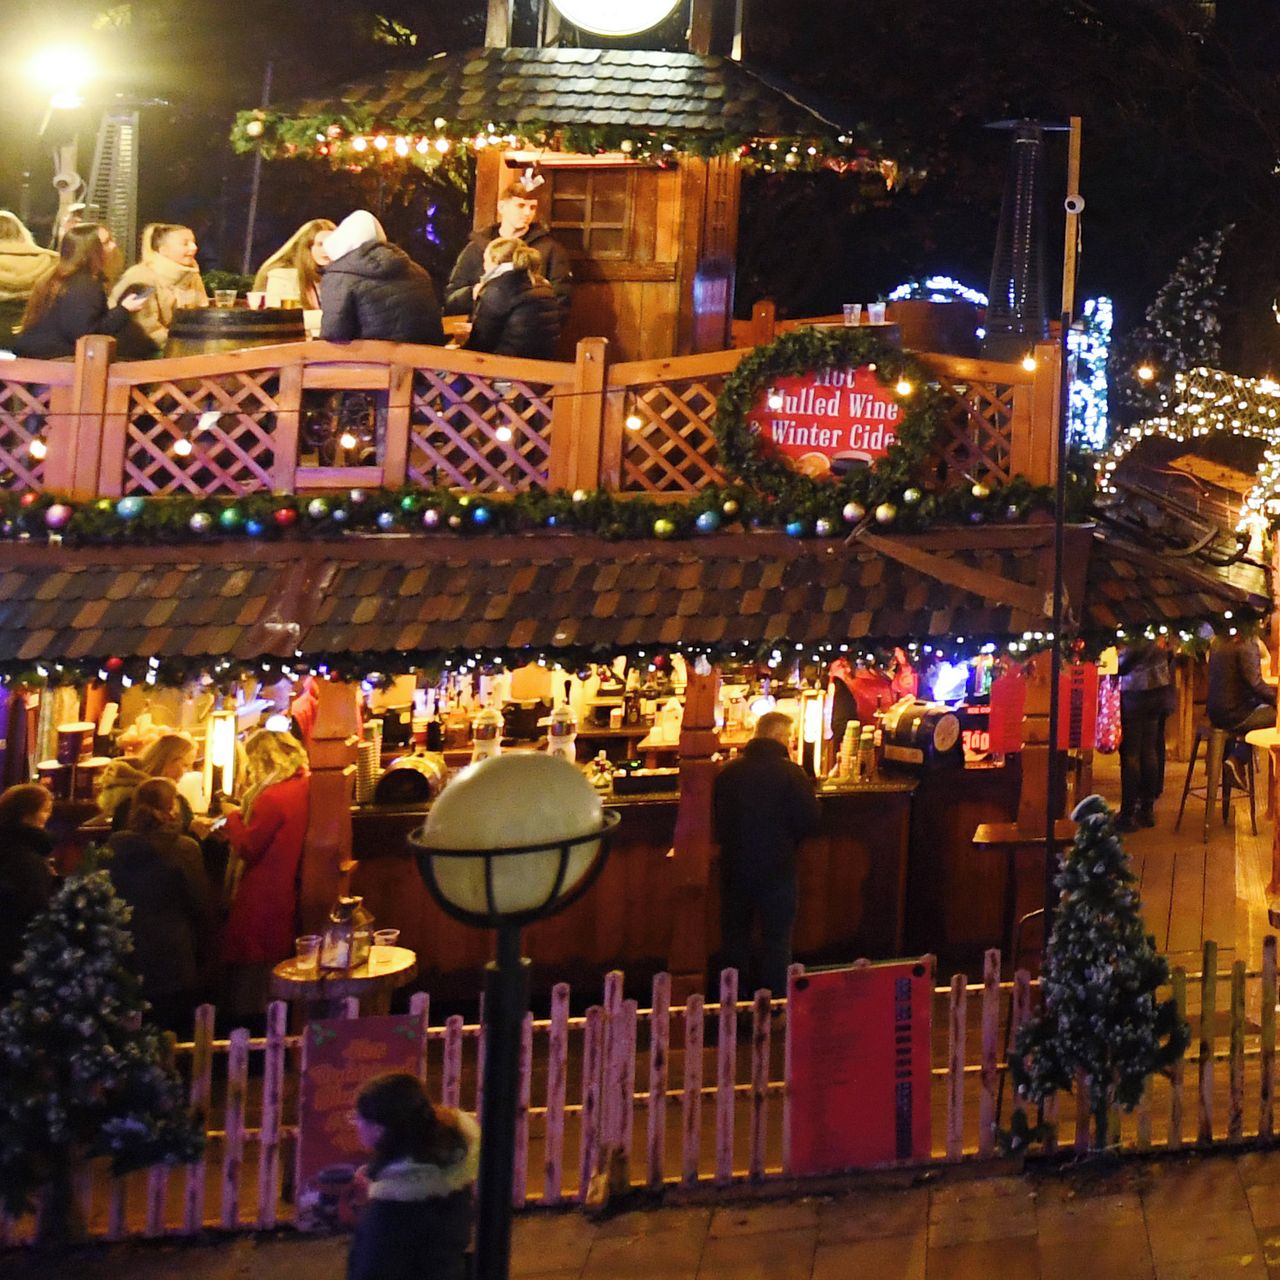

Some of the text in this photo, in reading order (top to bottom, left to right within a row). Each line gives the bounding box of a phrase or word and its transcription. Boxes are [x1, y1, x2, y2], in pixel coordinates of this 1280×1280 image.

[814, 367, 857, 389] Hot
[849, 393, 899, 421] Wine
[771, 419, 843, 448] Winter
[849, 423, 902, 451] Cide
